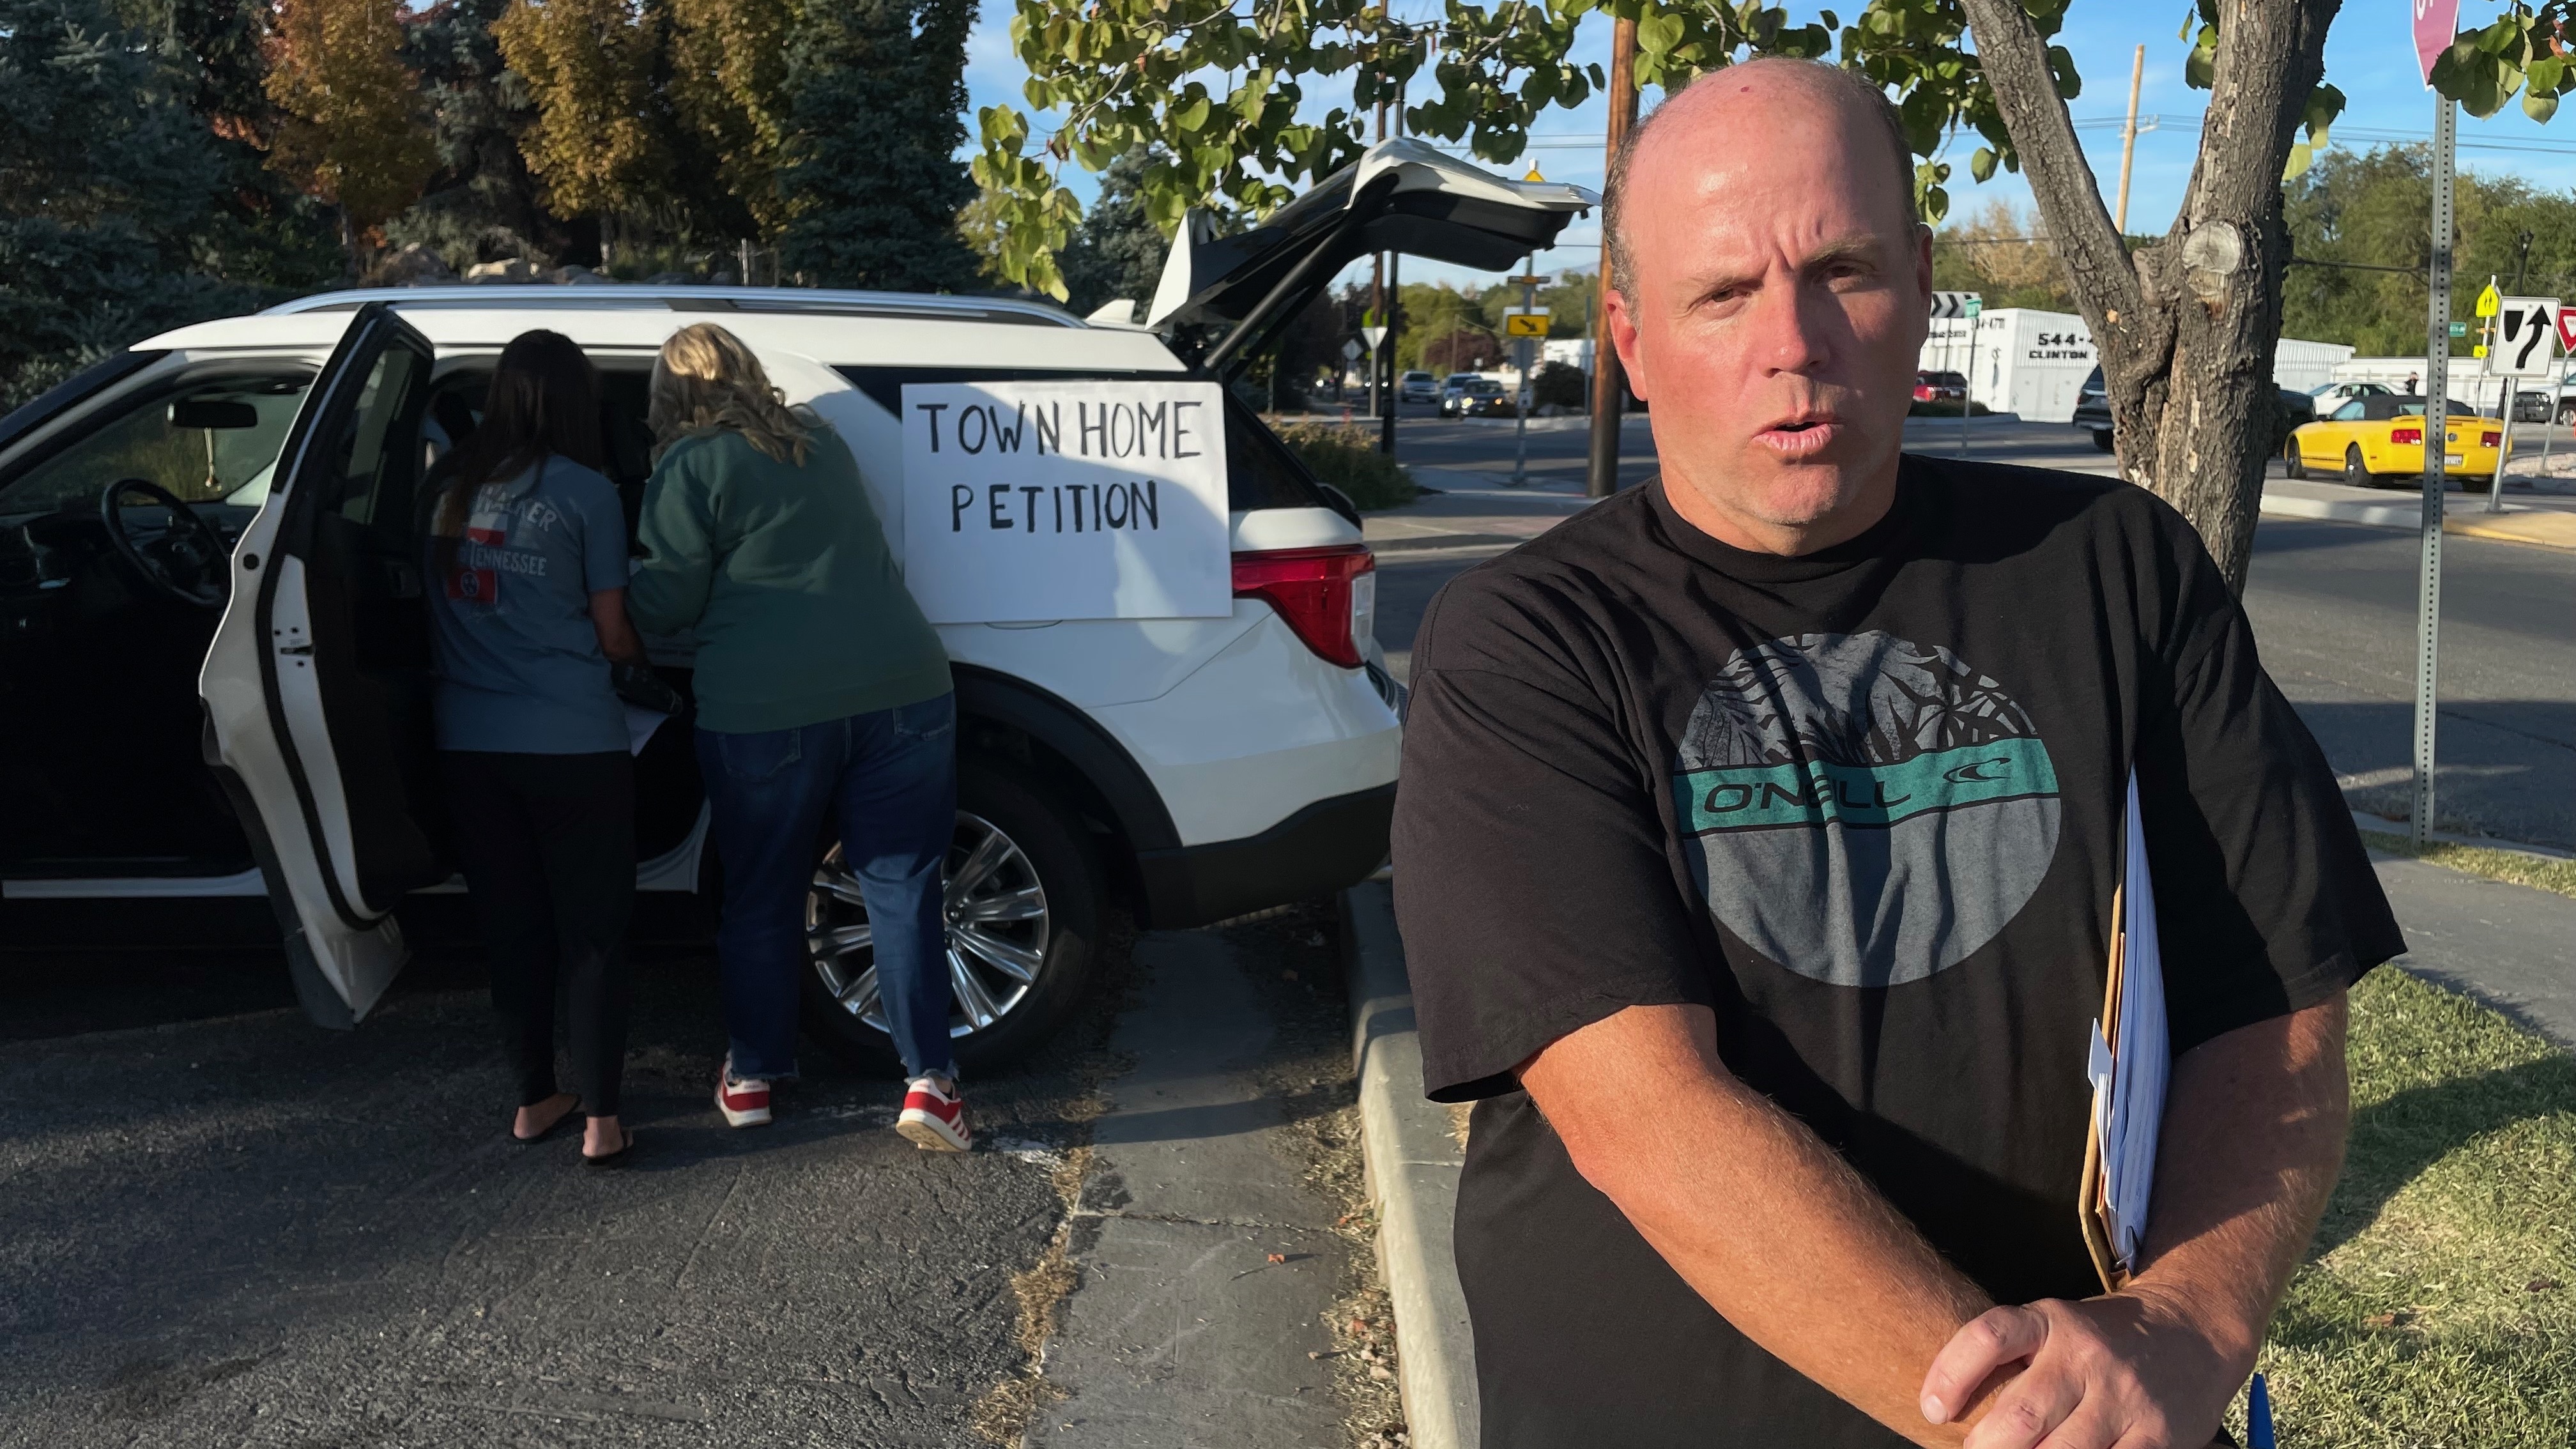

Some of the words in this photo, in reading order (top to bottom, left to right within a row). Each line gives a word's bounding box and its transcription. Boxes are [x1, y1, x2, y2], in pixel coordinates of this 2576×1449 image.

[2029, 350, 2087, 359] CLINTON
[2038, 332, 2094, 346] 544-
[916, 401, 1061, 456] TOWN
[1078, 401, 1202, 459] HOME
[951, 480, 1158, 533] PETITION
[468, 539, 547, 576] TENNESSEE
